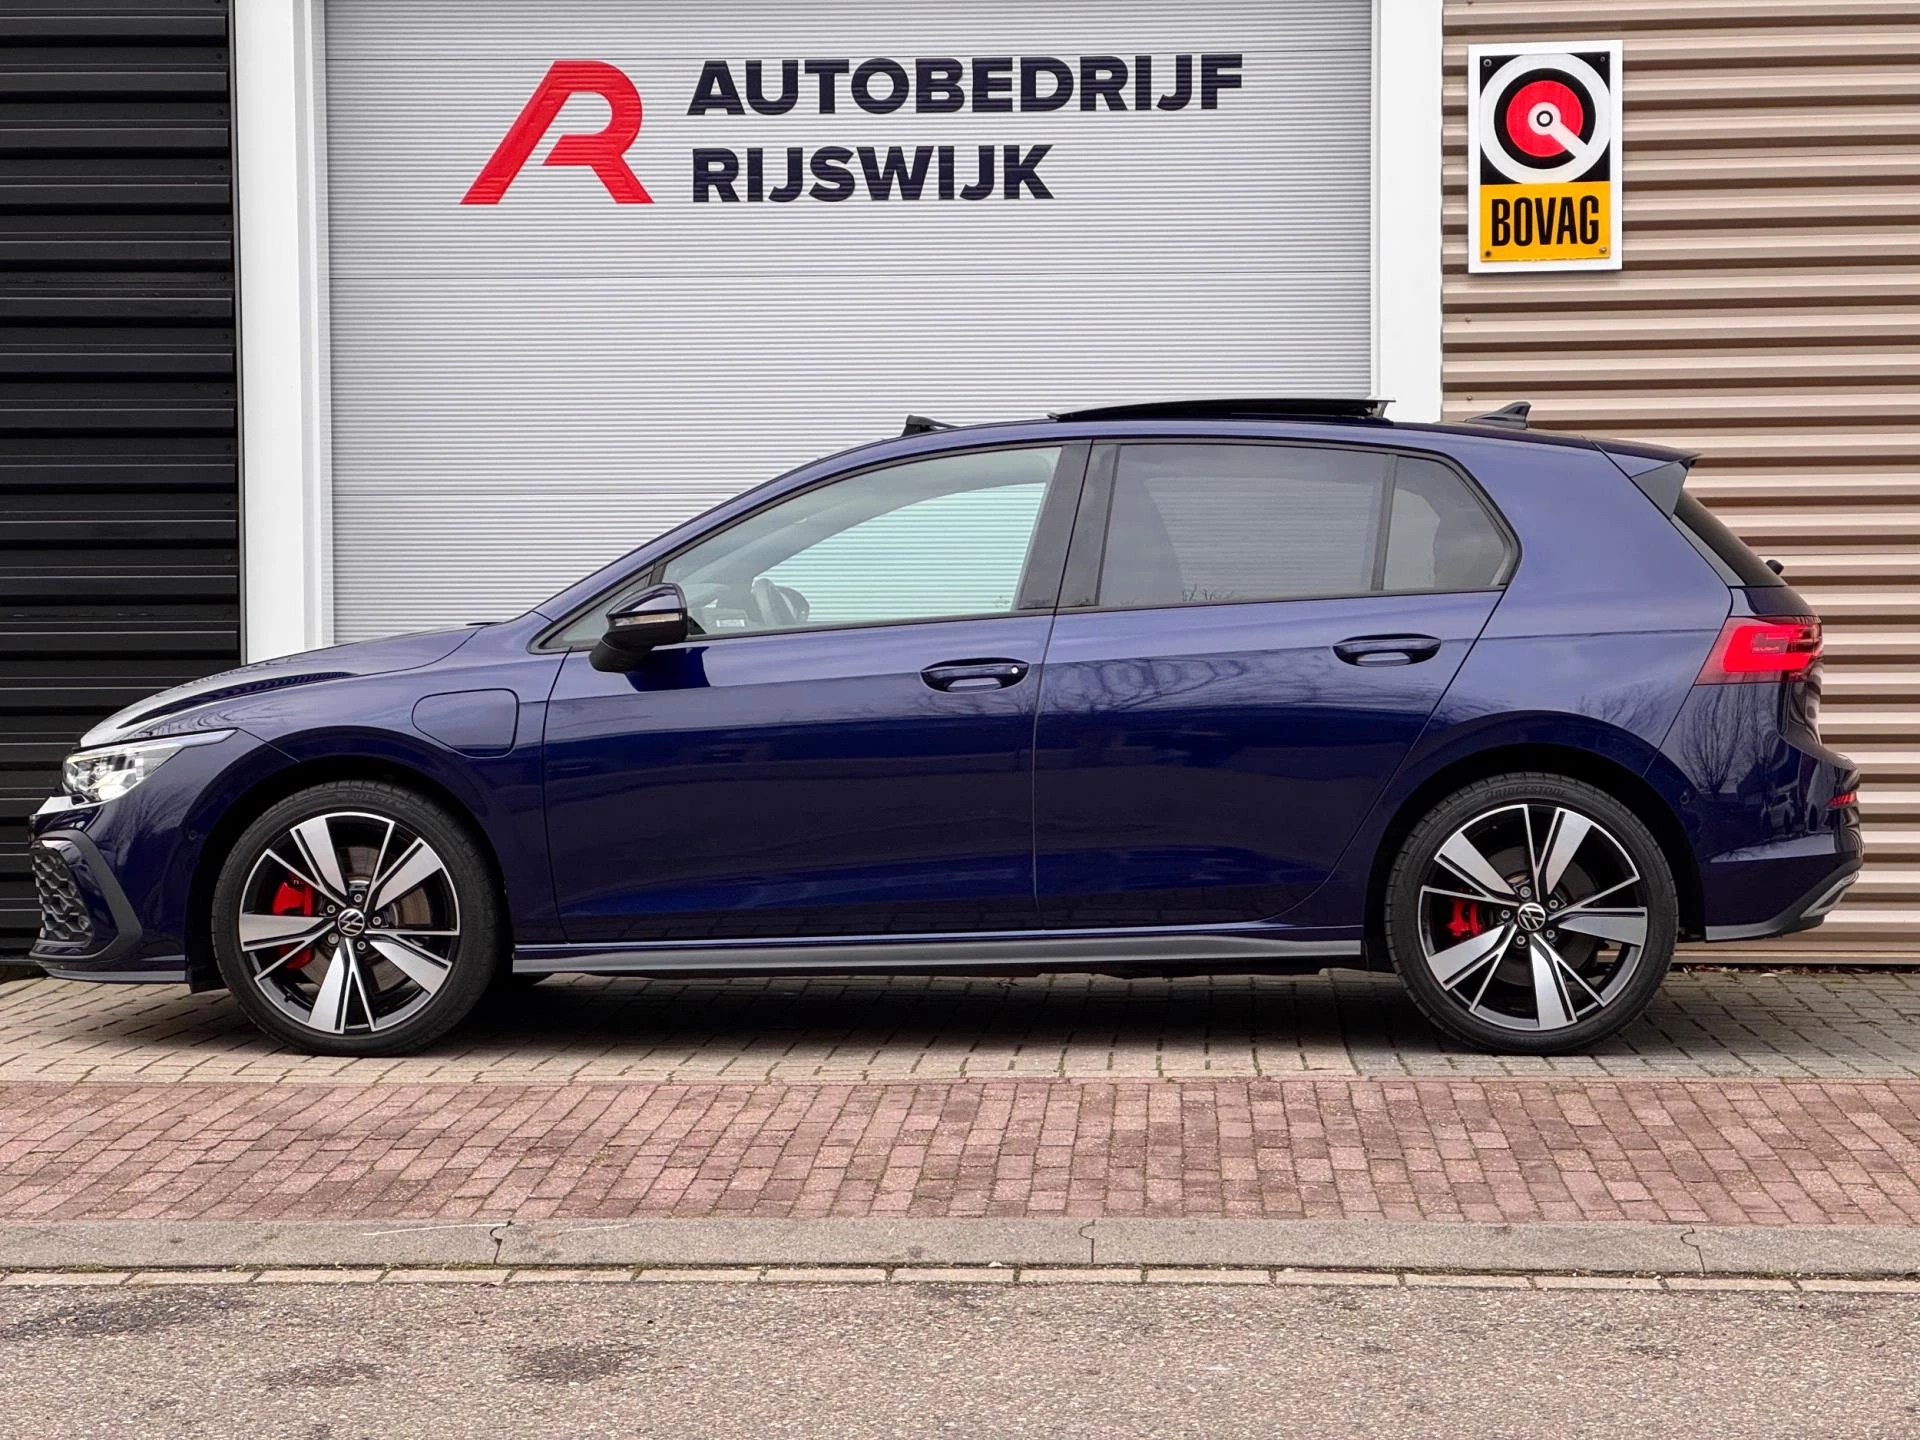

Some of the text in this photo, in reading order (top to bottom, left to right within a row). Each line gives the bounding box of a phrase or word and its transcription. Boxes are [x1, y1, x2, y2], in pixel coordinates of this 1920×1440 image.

[687, 54, 1243, 116] AUTOBEDRIJF
[692, 144, 1055, 203] RIJSWIJK
[1491, 194, 1600, 247] BOVAG
